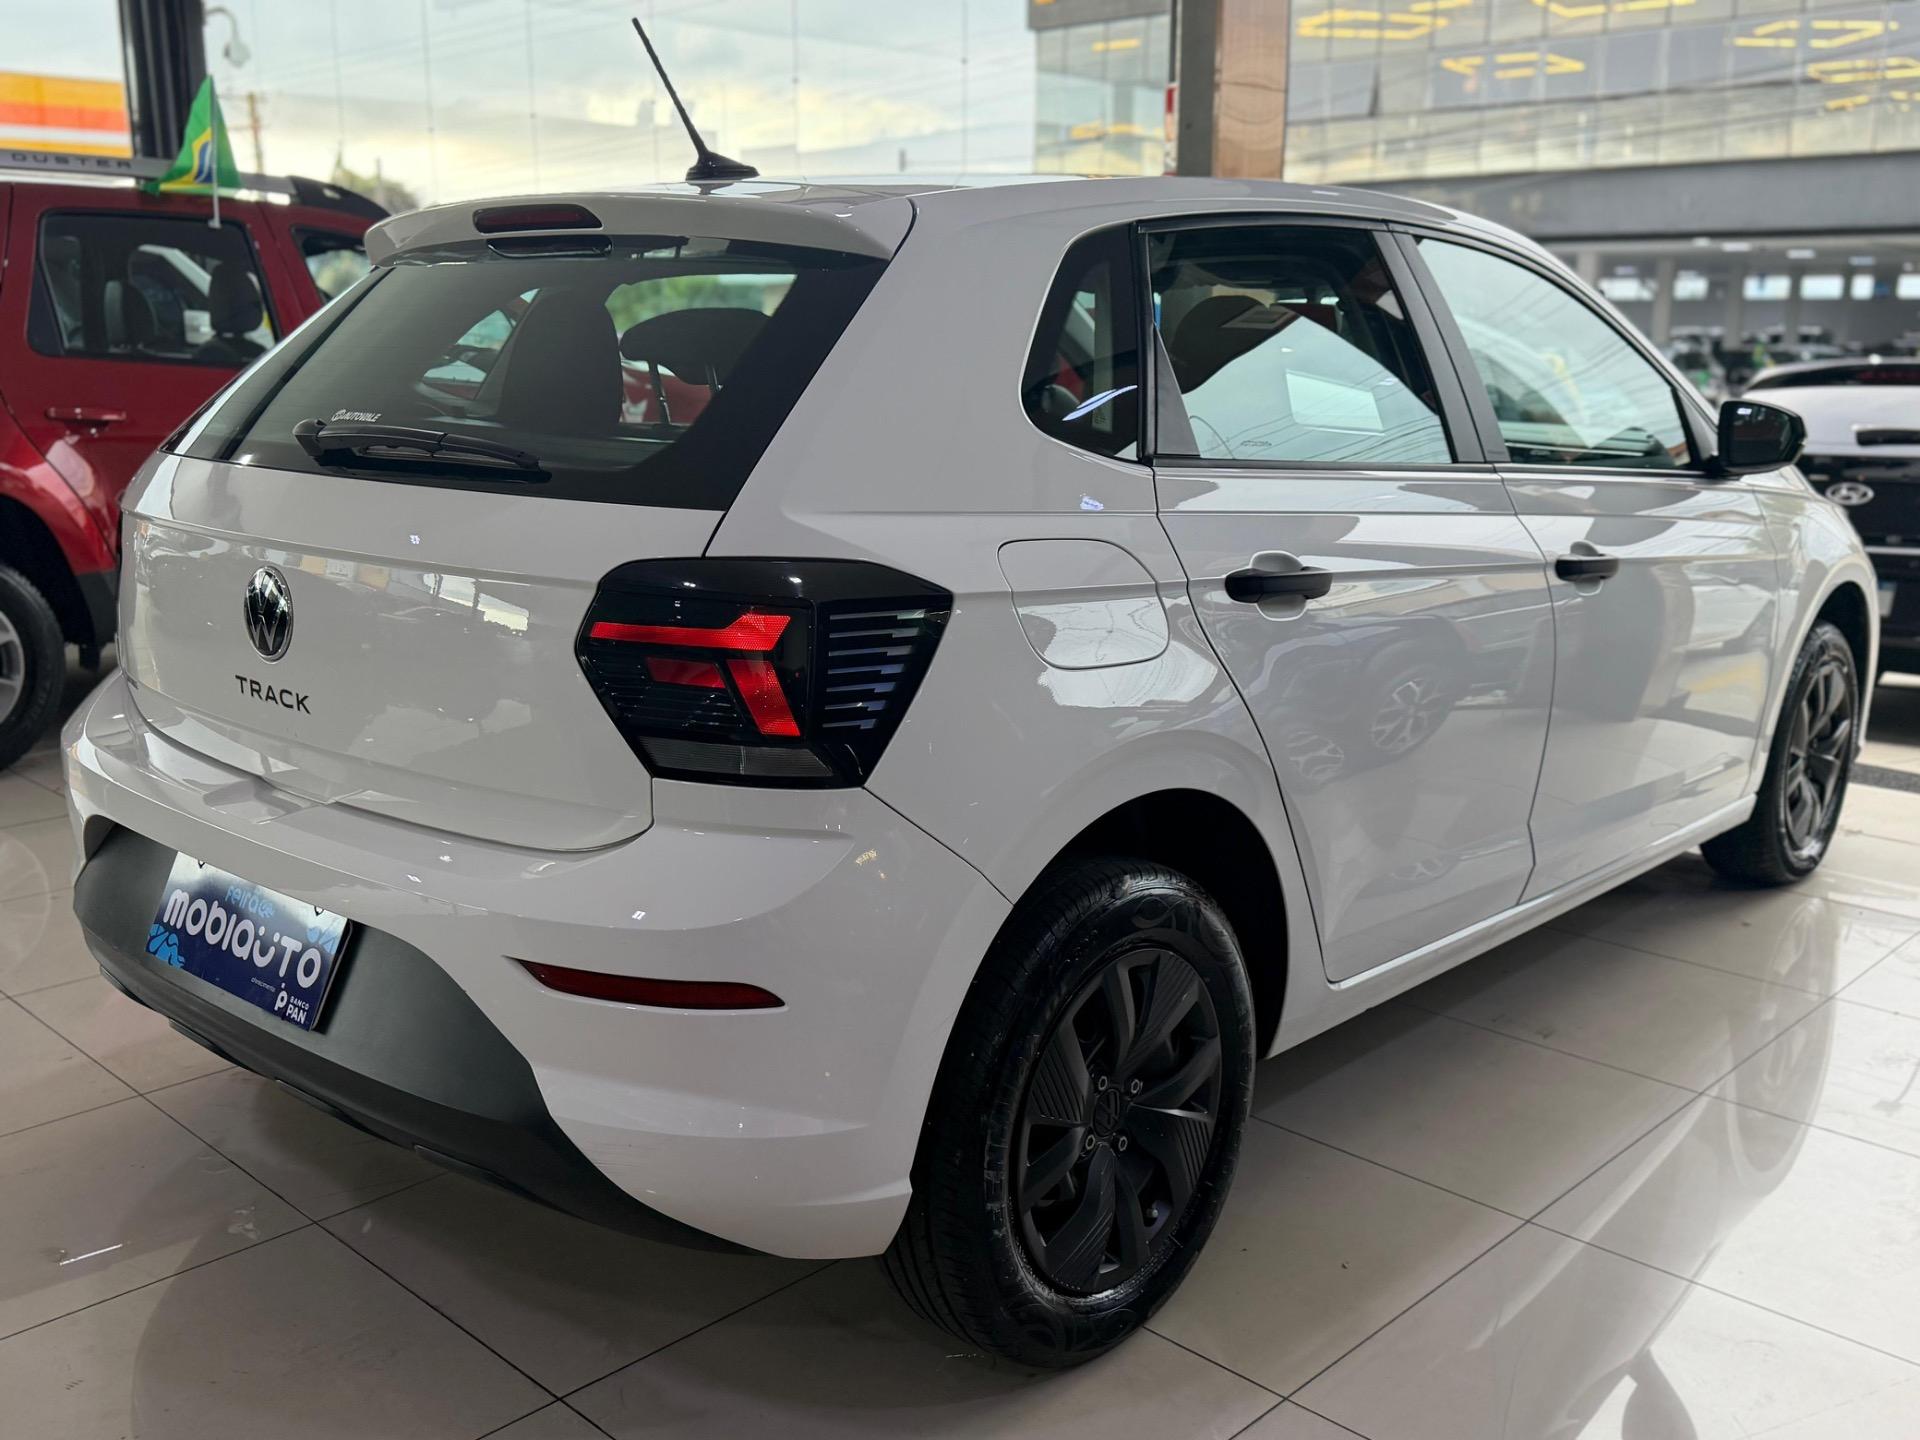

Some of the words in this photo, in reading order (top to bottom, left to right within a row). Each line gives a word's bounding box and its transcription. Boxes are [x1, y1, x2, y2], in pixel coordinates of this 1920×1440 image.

[11, 152, 132, 169] DUSTER
[235, 674, 311, 715] TRACK
[290, 995, 310, 1010] BANCO
[286, 1004, 307, 1024] PAN
